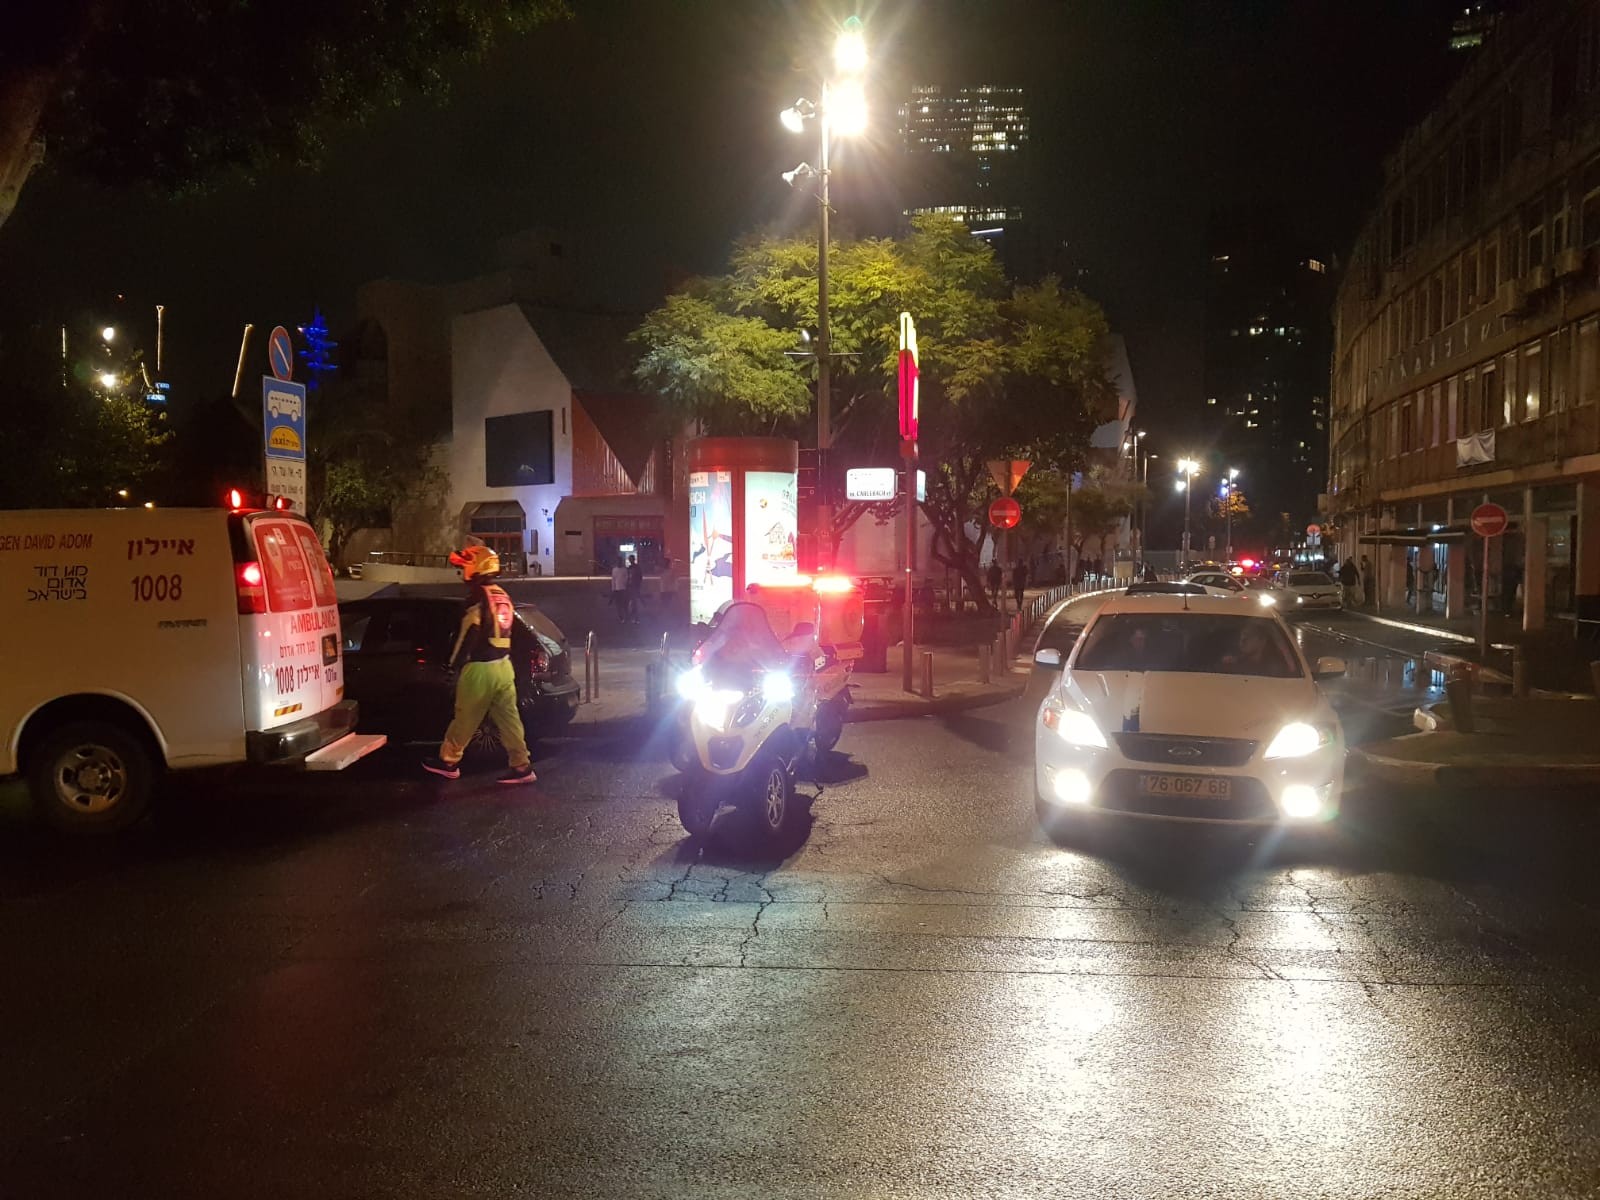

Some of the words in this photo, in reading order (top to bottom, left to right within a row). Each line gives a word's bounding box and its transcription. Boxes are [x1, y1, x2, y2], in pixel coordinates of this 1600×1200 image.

[0, 535, 20, 551] GEN
[24, 534, 55, 549] DAVID
[59, 533, 93, 549] ADOM
[127, 537, 195, 560] איילון
[33, 565, 59, 577] דוד
[64, 565, 88, 577] מגן
[47, 576, 87, 589] אדום
[131, 574, 182, 602] 1008
[27, 588, 87, 601] בישראל
[290, 609, 337, 635] AMBULANCE
[276, 665, 295, 695] 1008
[297, 664, 320, 690] איילון
